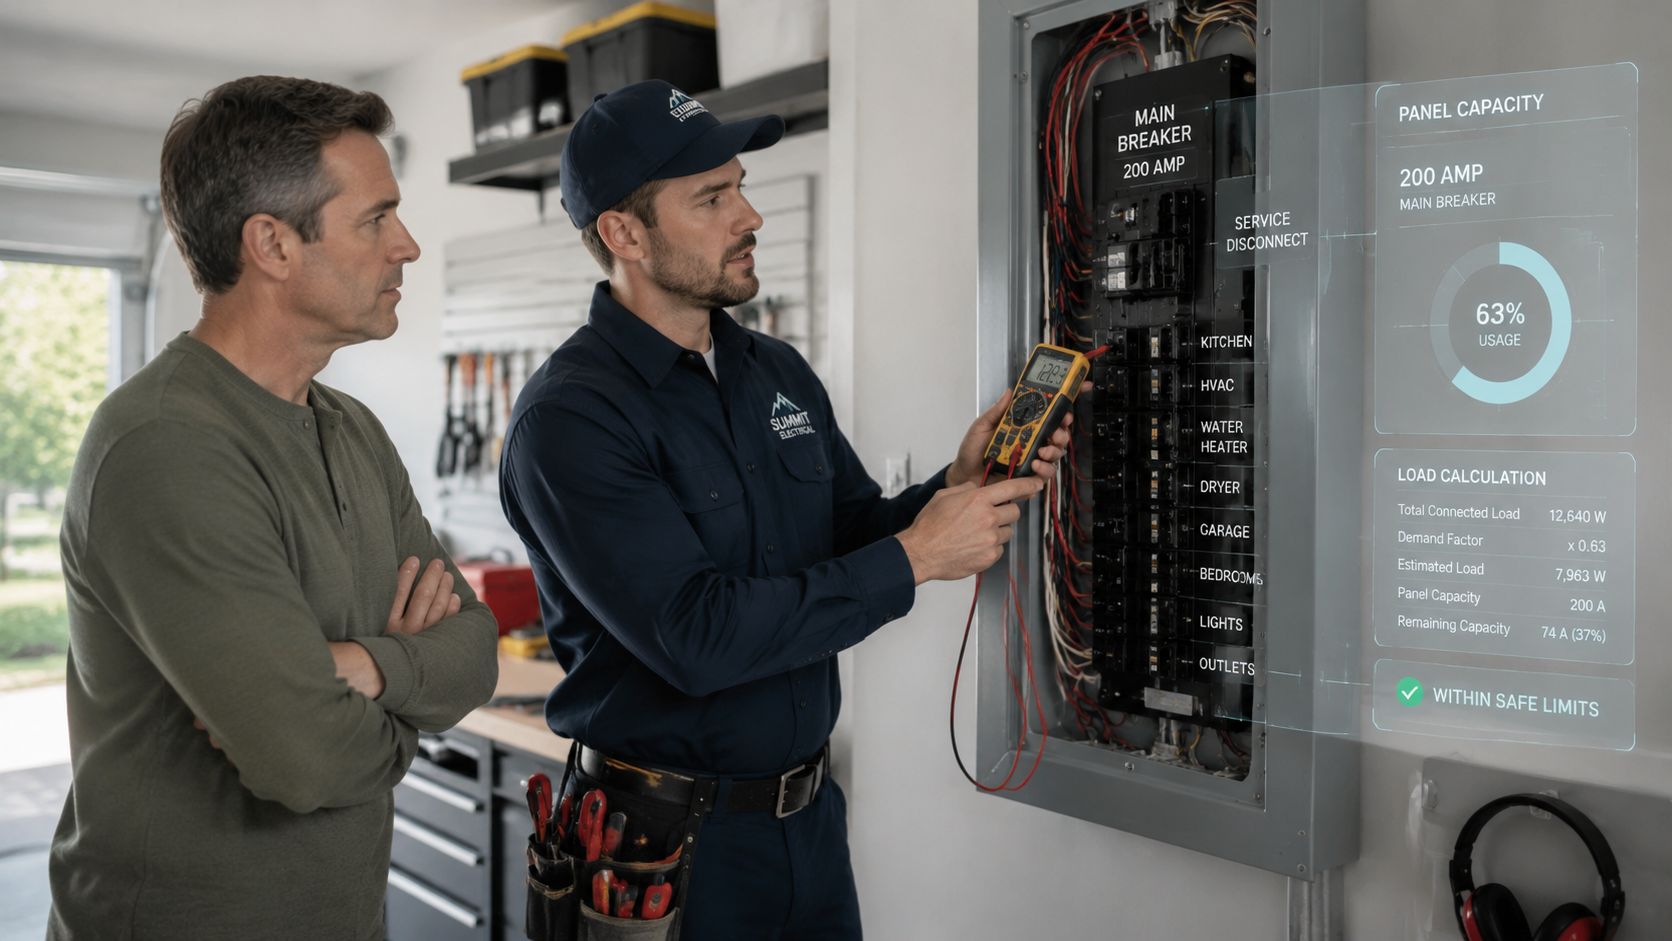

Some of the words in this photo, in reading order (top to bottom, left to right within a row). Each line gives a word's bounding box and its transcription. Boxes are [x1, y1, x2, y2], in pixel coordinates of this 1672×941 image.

[1135, 103, 1175, 127] MAIN
[1117, 123, 1192, 153] BREAKER
[1123, 161, 1150, 179] 200
[1152, 155, 1186, 175] AMP
[1200, 334, 1253, 349] KITCHEN
[1201, 378, 1235, 392] HVAC
[770, 411, 811, 431] SUMMIT
[1200, 420, 1244, 434] WATER
[1201, 440, 1248, 454] HEATER
[1200, 479, 1241, 494] DRYER
[1200, 523, 1250, 539] GARAGE
[1200, 615, 1243, 632] LIGHTS
[1199, 657, 1256, 676] OUTLETS
